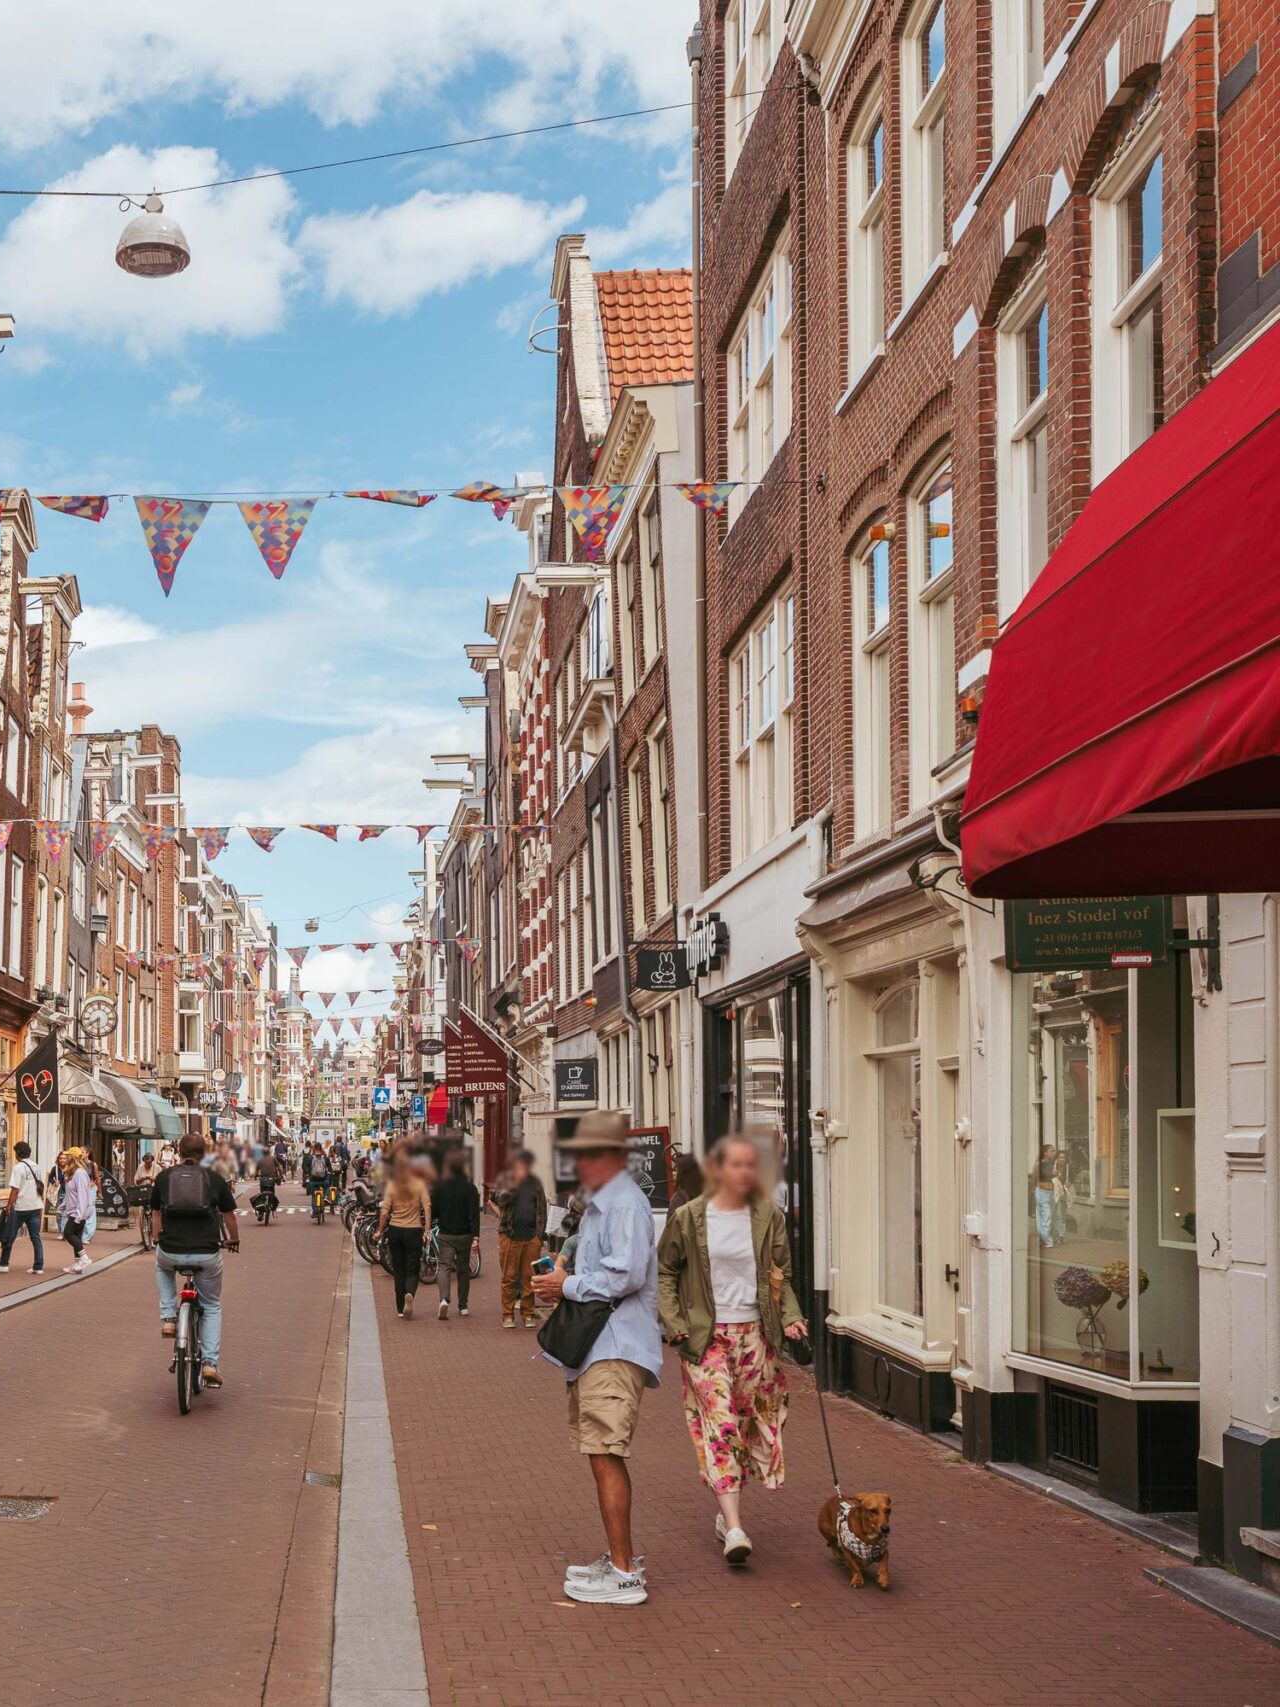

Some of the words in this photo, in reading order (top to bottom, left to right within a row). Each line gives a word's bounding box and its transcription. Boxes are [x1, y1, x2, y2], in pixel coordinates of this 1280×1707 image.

[1028, 912, 1062, 925] Inez
[1067, 908, 1117, 923] Stodel
[1123, 906, 1150, 920] vof
[464, 1082, 505, 1092] BRUENS
[67, 1095, 86, 1103] Coffee
[199, 1092, 216, 1103] STACH
[415, 1098, 421, 1109] P
[106, 1115, 137, 1125] clocks
[618, 1579, 641, 1590] HOKA
